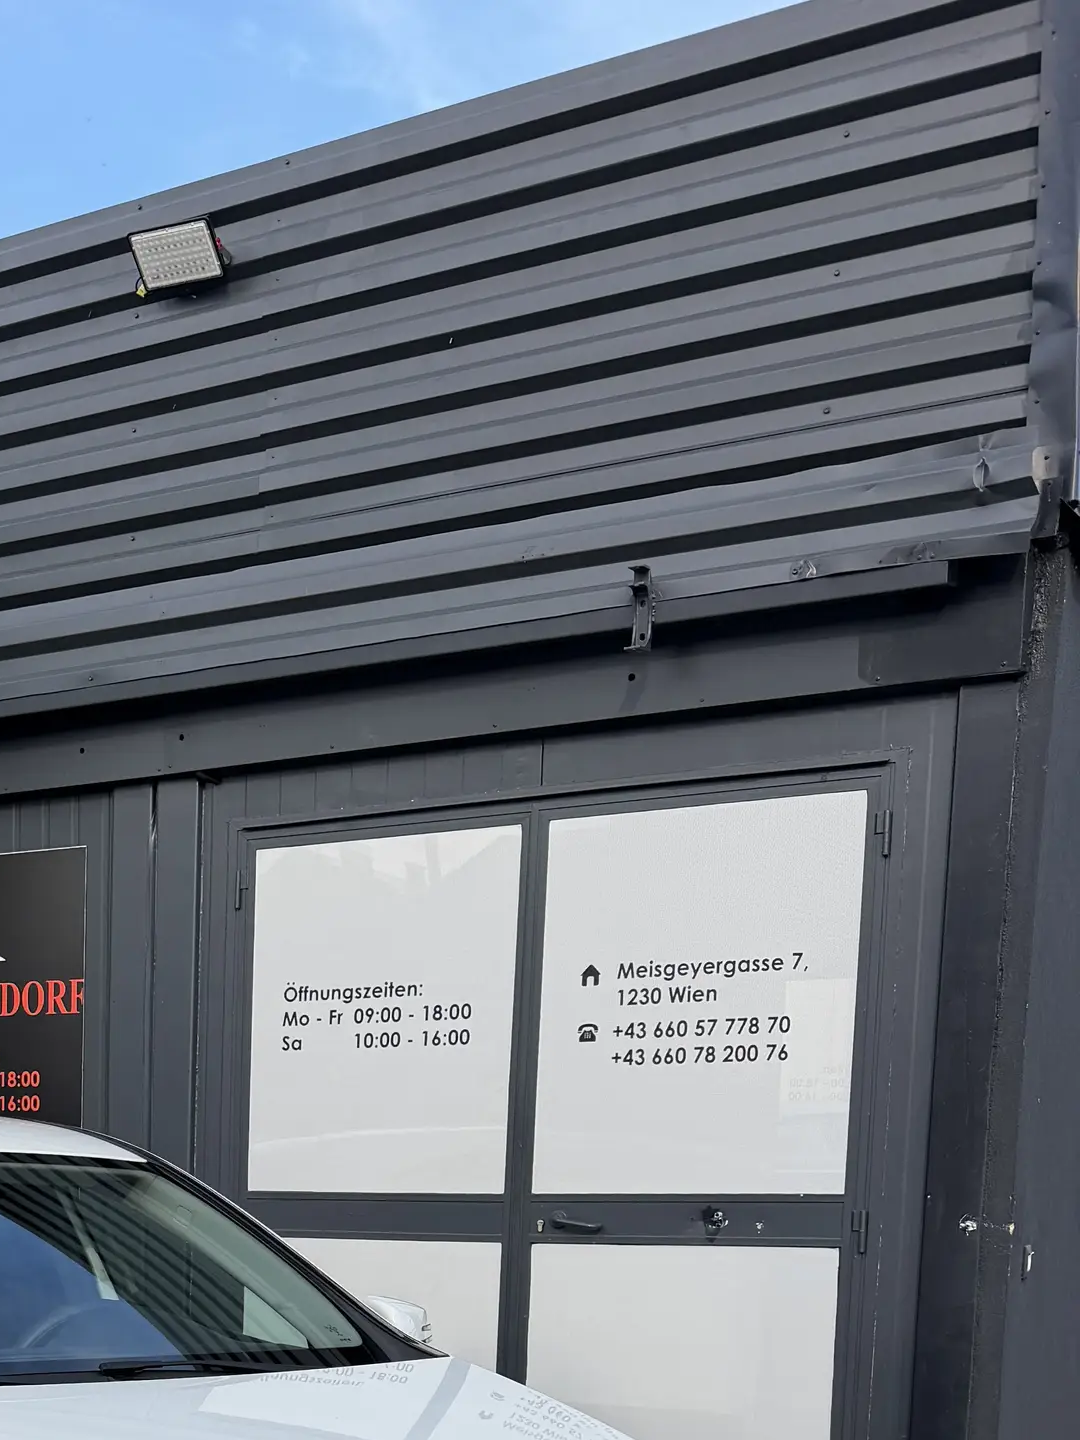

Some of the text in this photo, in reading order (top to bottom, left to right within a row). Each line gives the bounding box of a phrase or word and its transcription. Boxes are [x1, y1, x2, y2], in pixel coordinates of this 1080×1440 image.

[617, 952, 809, 981] Meisgeyergasse 7,
[283, 981, 423, 1003] Öffnungszeiten:
[618, 985, 717, 1006] 1230 Wien
[282, 1011, 310, 1027] Mo
[329, 1009, 344, 1025] Fr
[353, 1006, 402, 1024] 09:00
[422, 1003, 472, 1021] 18:00
[612, 1015, 791, 1039] +43 660 57 778 70
[281, 1035, 303, 1051] Sa
[354, 1031, 401, 1049] 10:00
[422, 1029, 471, 1047] 16:00
[611, 1043, 788, 1066] +43 660 78 200 76
[0, 1070, 41, 1088] 18:00
[0, 1094, 41, 1111] 16:00
